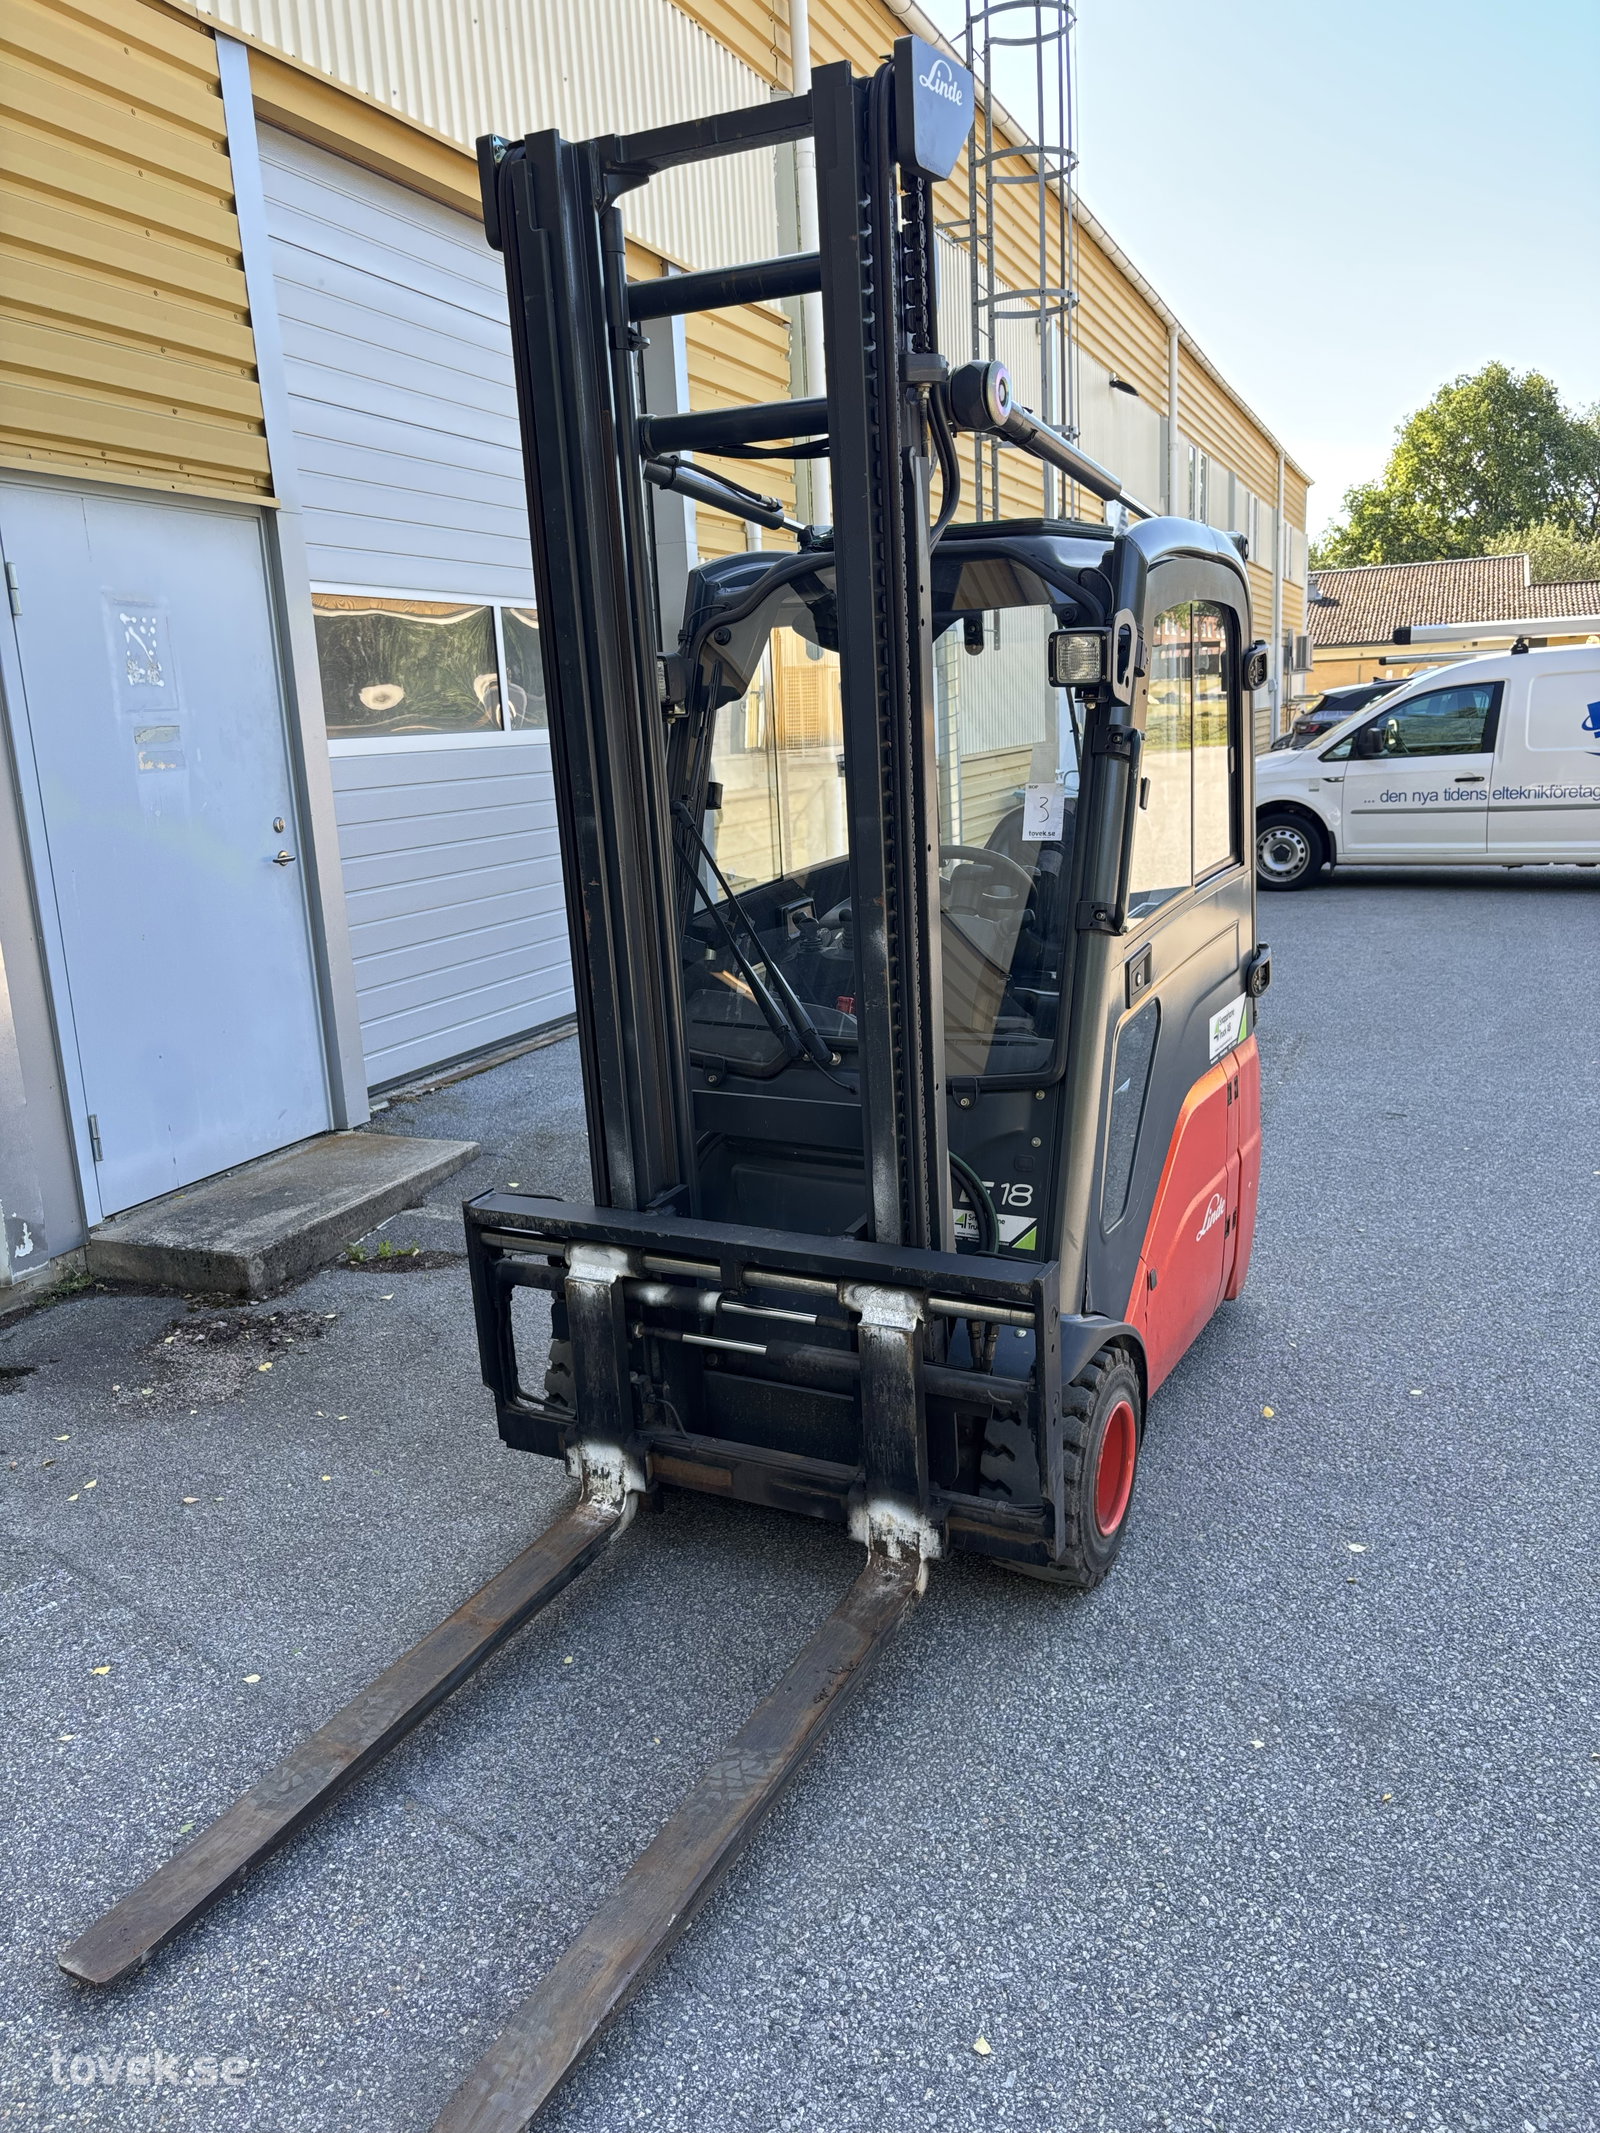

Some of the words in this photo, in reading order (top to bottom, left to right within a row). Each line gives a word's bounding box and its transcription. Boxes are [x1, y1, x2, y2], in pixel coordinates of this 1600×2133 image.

[919, 59, 963, 106] Linde
[1039, 796, 1050, 823] 3
[1380, 789, 1407, 803] den
[1412, 791, 1439, 806] nya
[1443, 787, 1488, 801] tidens
[1196, 1193, 1226, 1242] Linde
